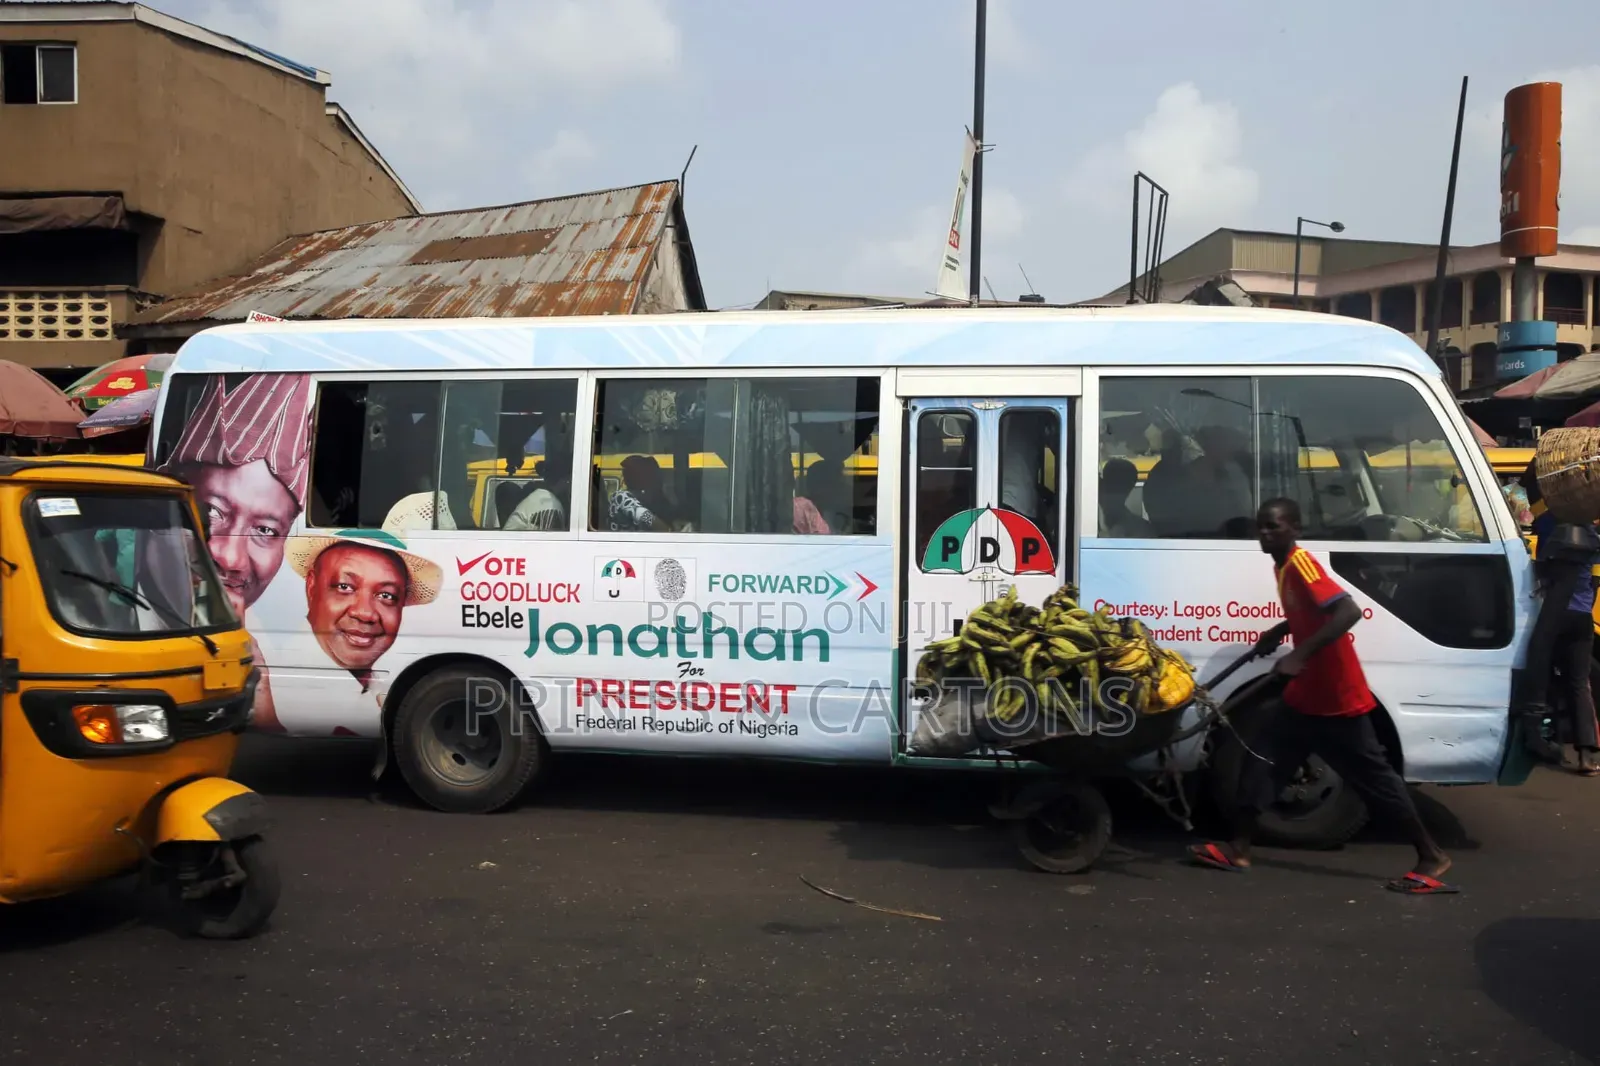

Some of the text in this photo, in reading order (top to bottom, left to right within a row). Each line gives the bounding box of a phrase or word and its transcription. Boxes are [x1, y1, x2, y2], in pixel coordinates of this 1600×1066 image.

[942, 535, 1040, 564] PDP
[456, 550, 526, 576] VOTE
[605, 567, 633, 576] PDP
[460, 581, 581, 604] GOODLUCK
[708, 573, 831, 596] FORWARD
[462, 604, 524, 629] Ebele
[1174, 600, 1221, 619] Lagos
[1226, 600, 1288, 619] Goodlu
[523, 608, 830, 662] Jonathan
[677, 661, 705, 679] For
[576, 677, 797, 714] PRESIDENT
[576, 714, 799, 739] Federal Republic of Nigeria
